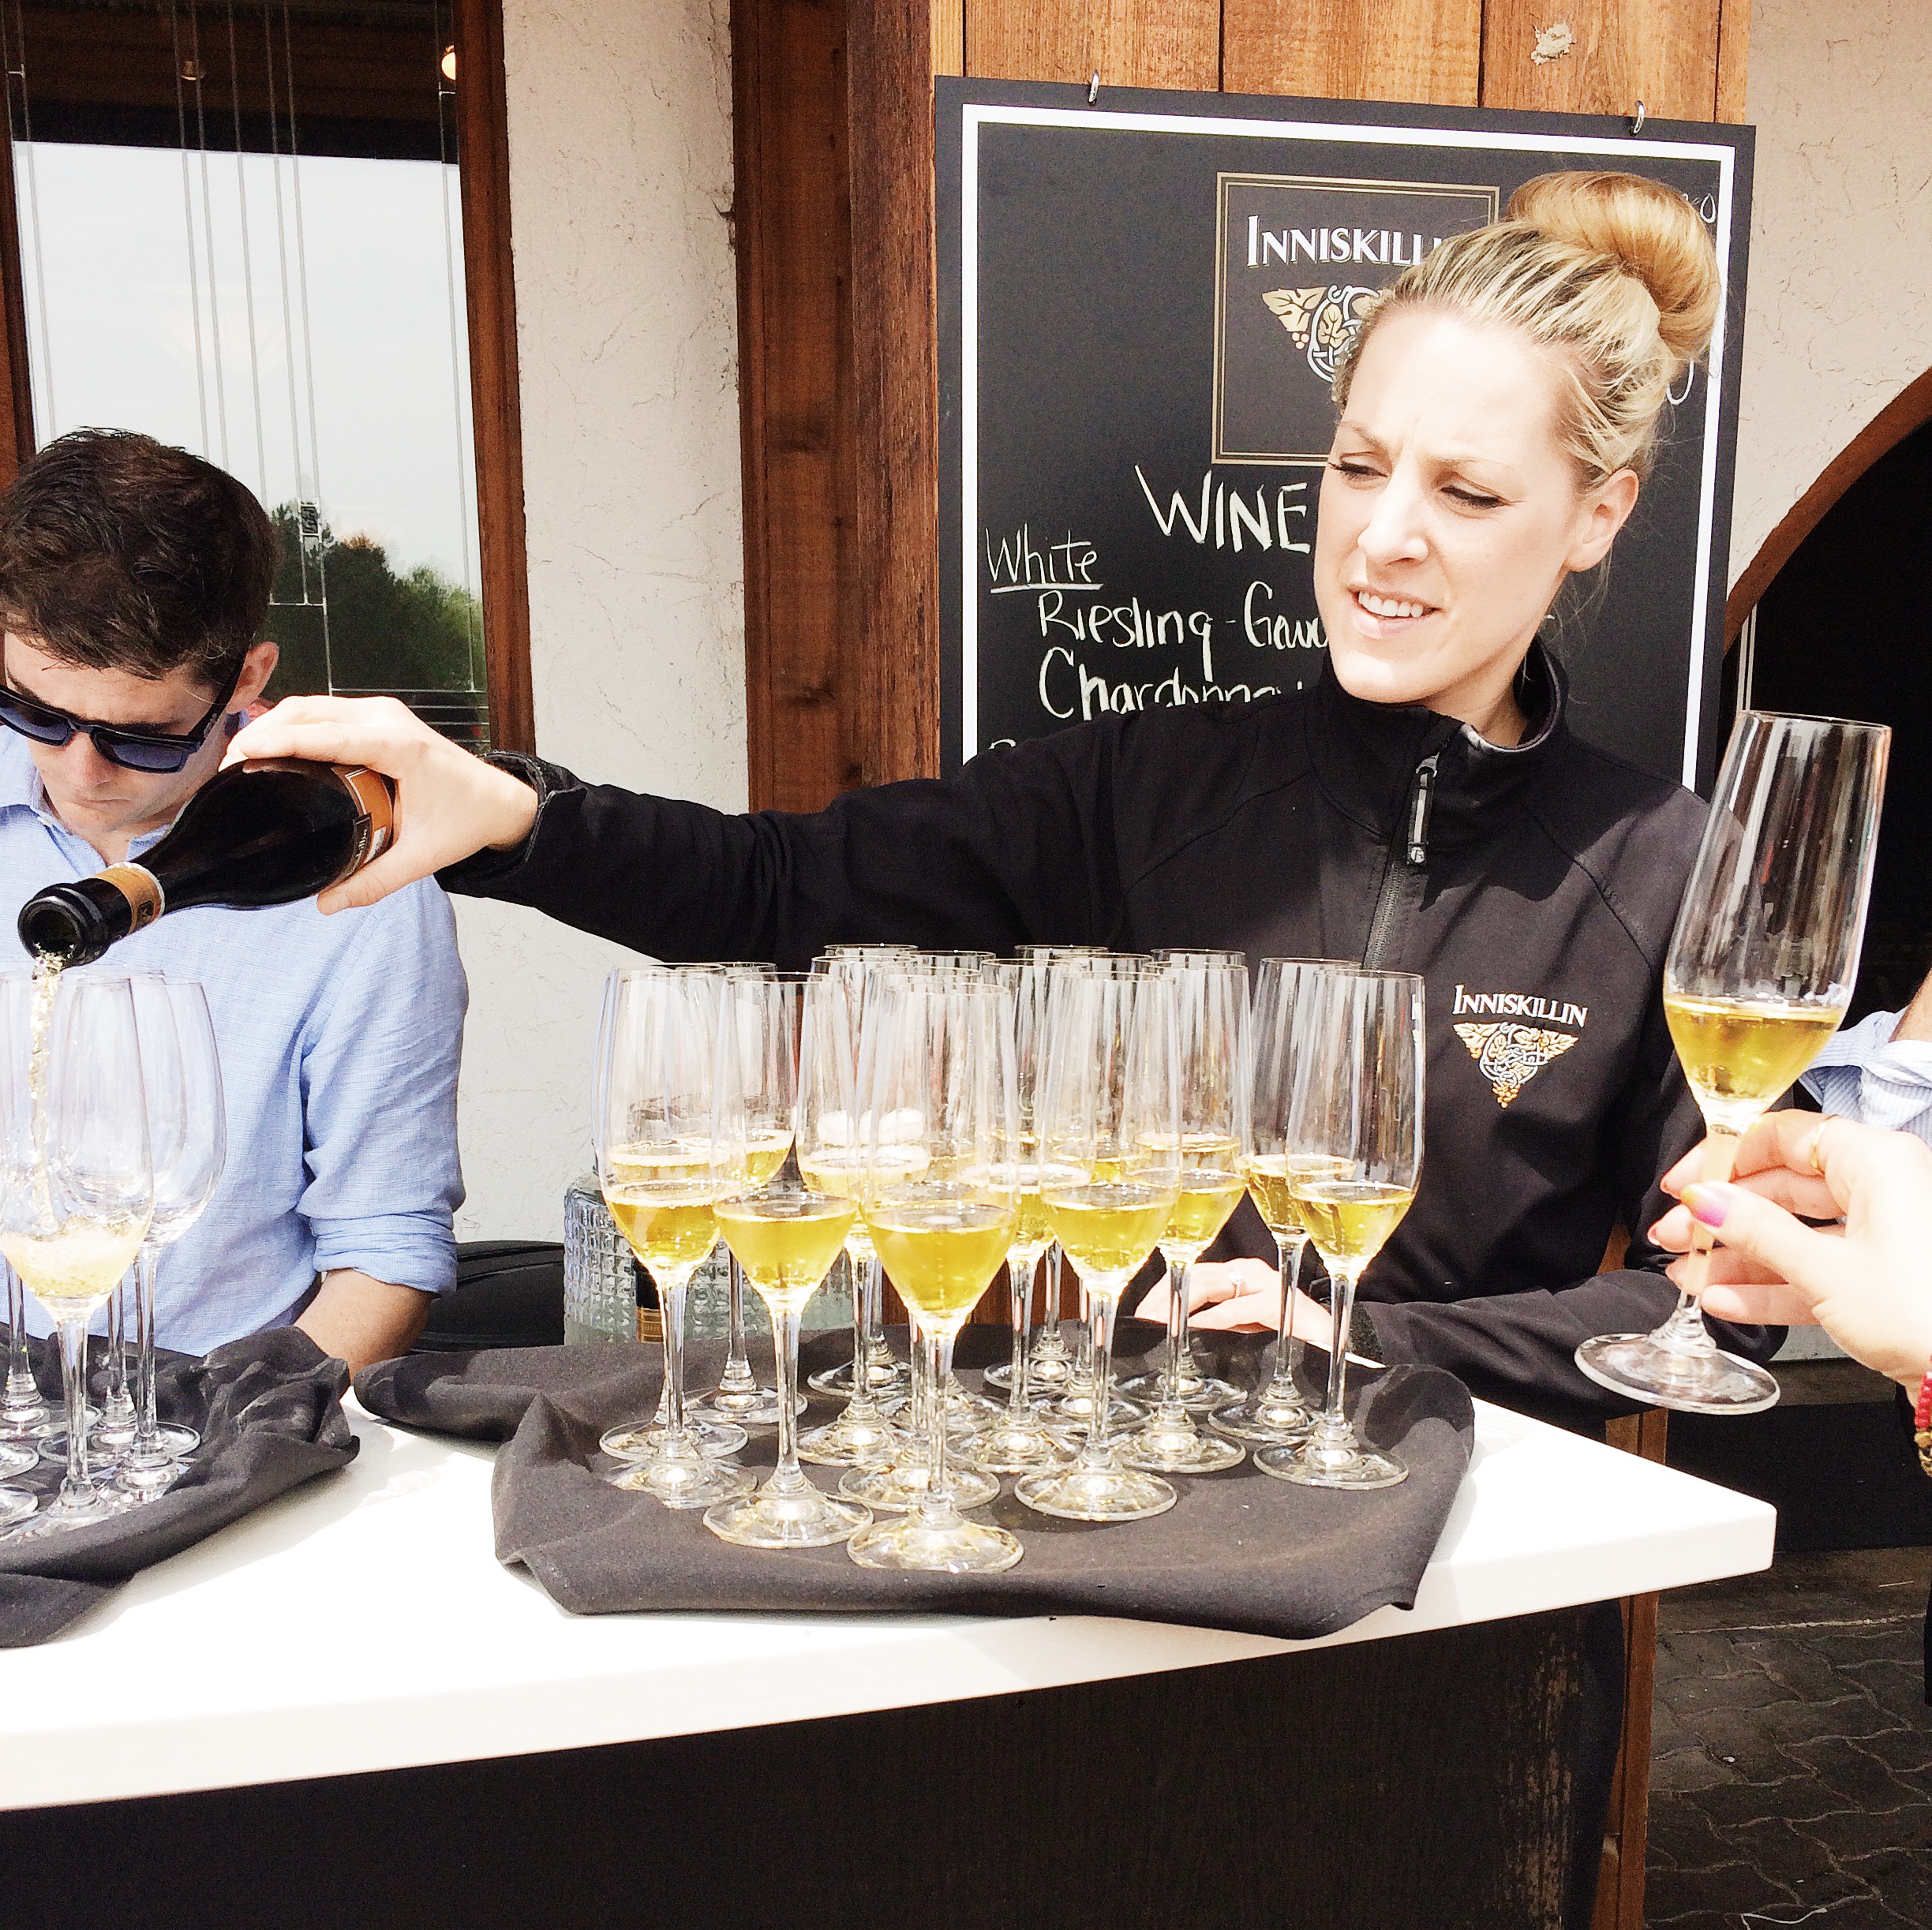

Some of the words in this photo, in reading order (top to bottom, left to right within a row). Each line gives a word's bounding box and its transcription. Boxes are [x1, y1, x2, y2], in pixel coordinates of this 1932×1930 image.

[1246, 215, 1443, 267] INNISKILL
[1134, 464, 1311, 554] WINE
[985, 522, 1098, 583] White
[1038, 589, 1214, 682] Riesling
[1451, 984, 1589, 1028] INNISKILLIN
